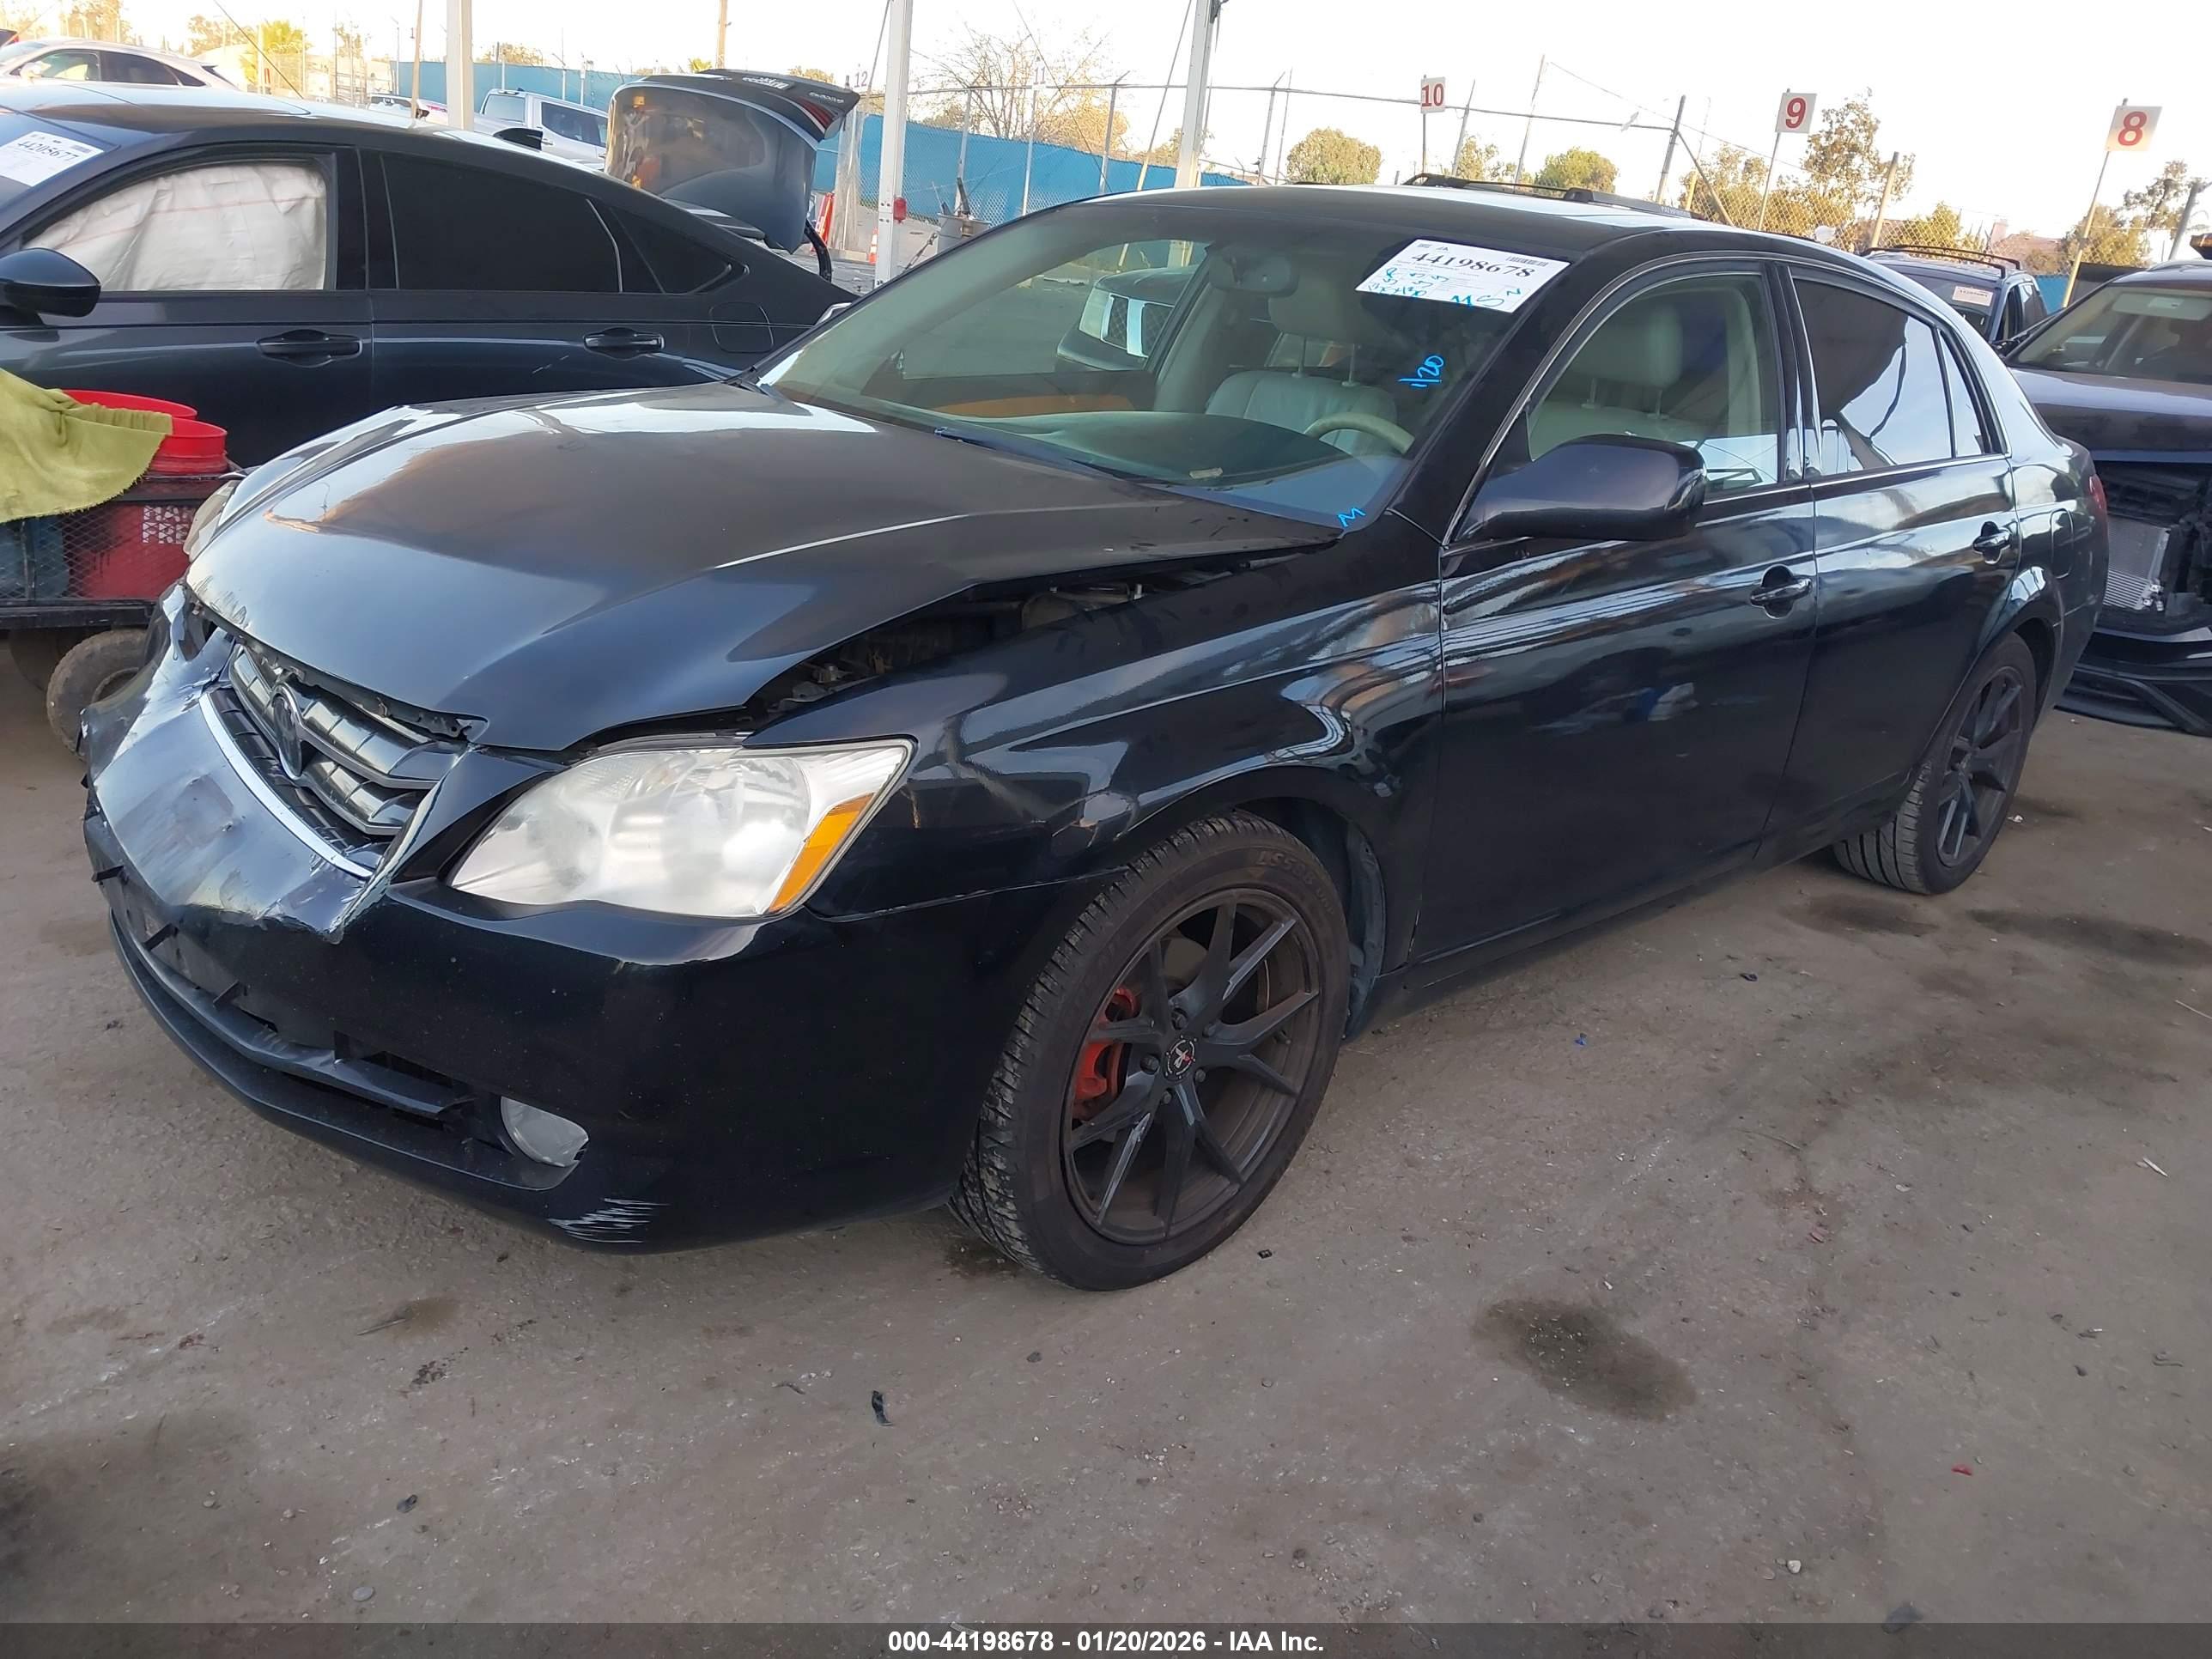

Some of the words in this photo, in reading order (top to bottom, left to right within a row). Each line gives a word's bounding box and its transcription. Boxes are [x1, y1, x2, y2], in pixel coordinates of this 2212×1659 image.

[854, 70, 867, 88] 12
[1421, 83, 1444, 106] 10
[1785, 97, 1806, 129] 9
[2118, 111, 2148, 146] 8
[1411, 252, 1535, 277] 44198678
